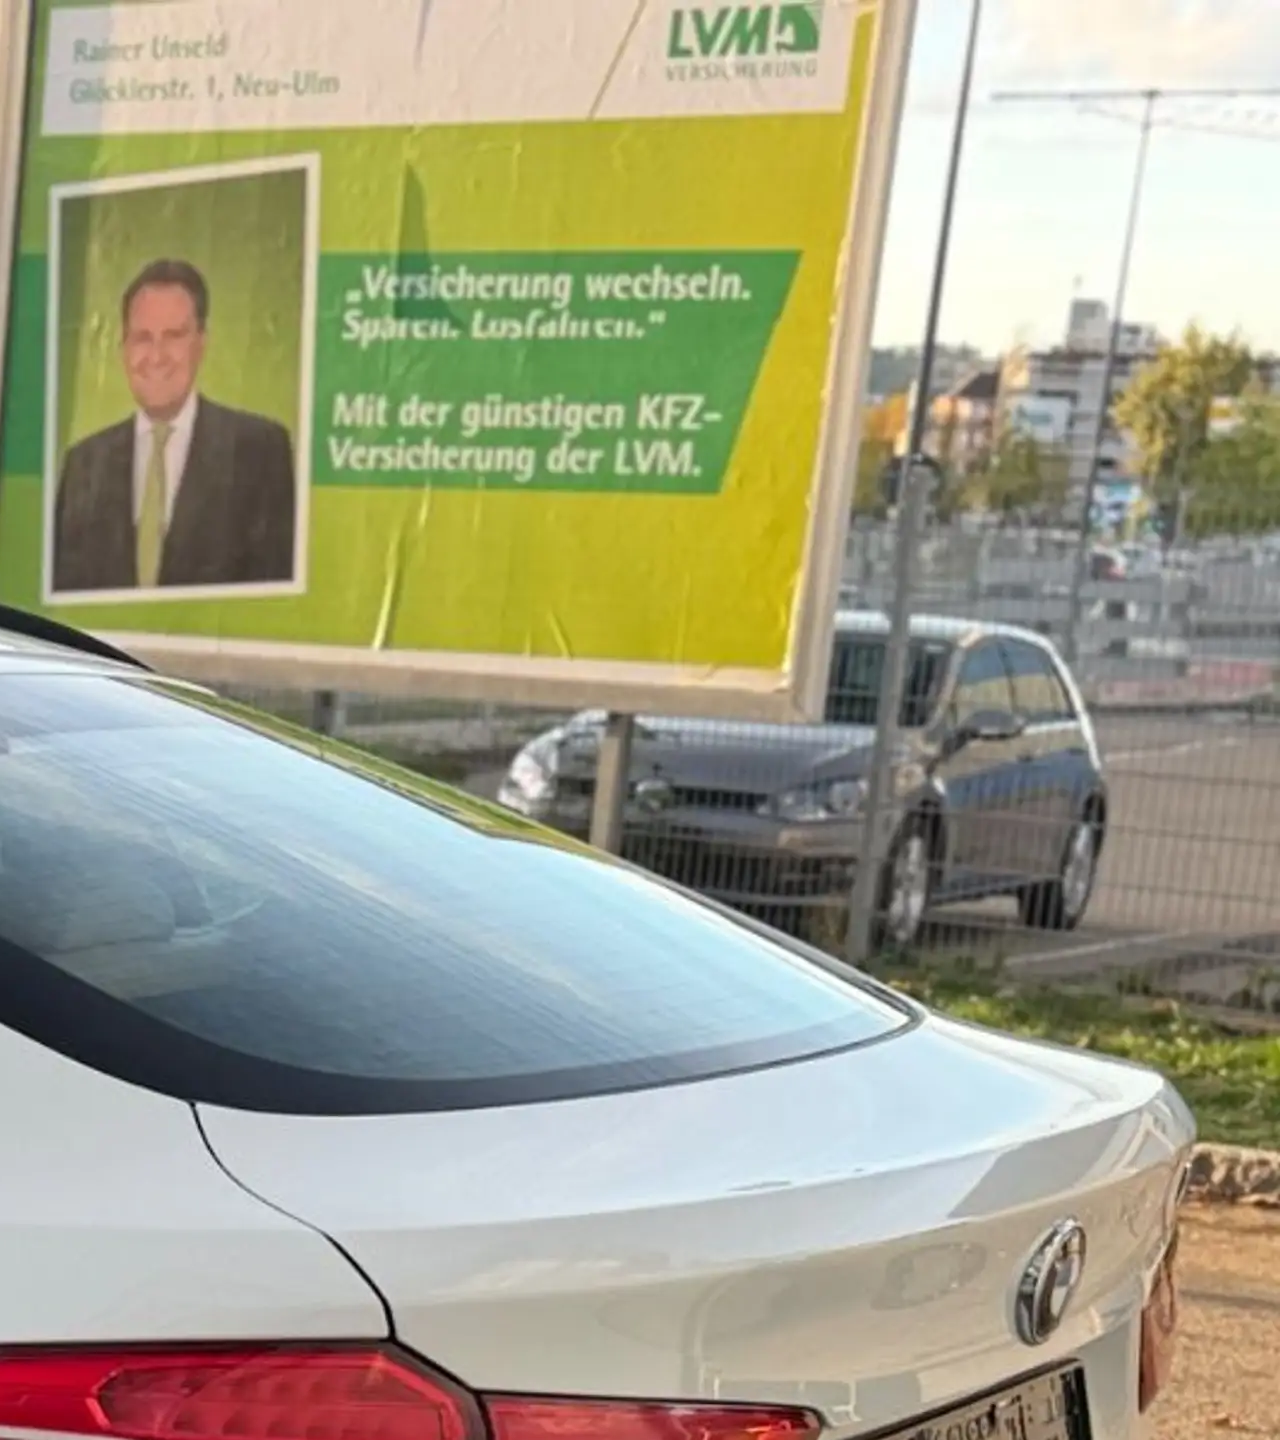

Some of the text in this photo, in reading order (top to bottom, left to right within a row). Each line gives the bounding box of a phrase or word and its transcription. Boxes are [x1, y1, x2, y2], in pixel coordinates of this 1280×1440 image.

[72, 32, 229, 63] Rainer Unseld
[667, 5, 772, 59] LVM
[232, 70, 341, 98] Neu-Ulm
[346, 264, 752, 309] „Versicherung wechseln.
[332, 393, 723, 437] Mit der günstigen KFZ-
[327, 436, 703, 483] Versicherung der LVM.
